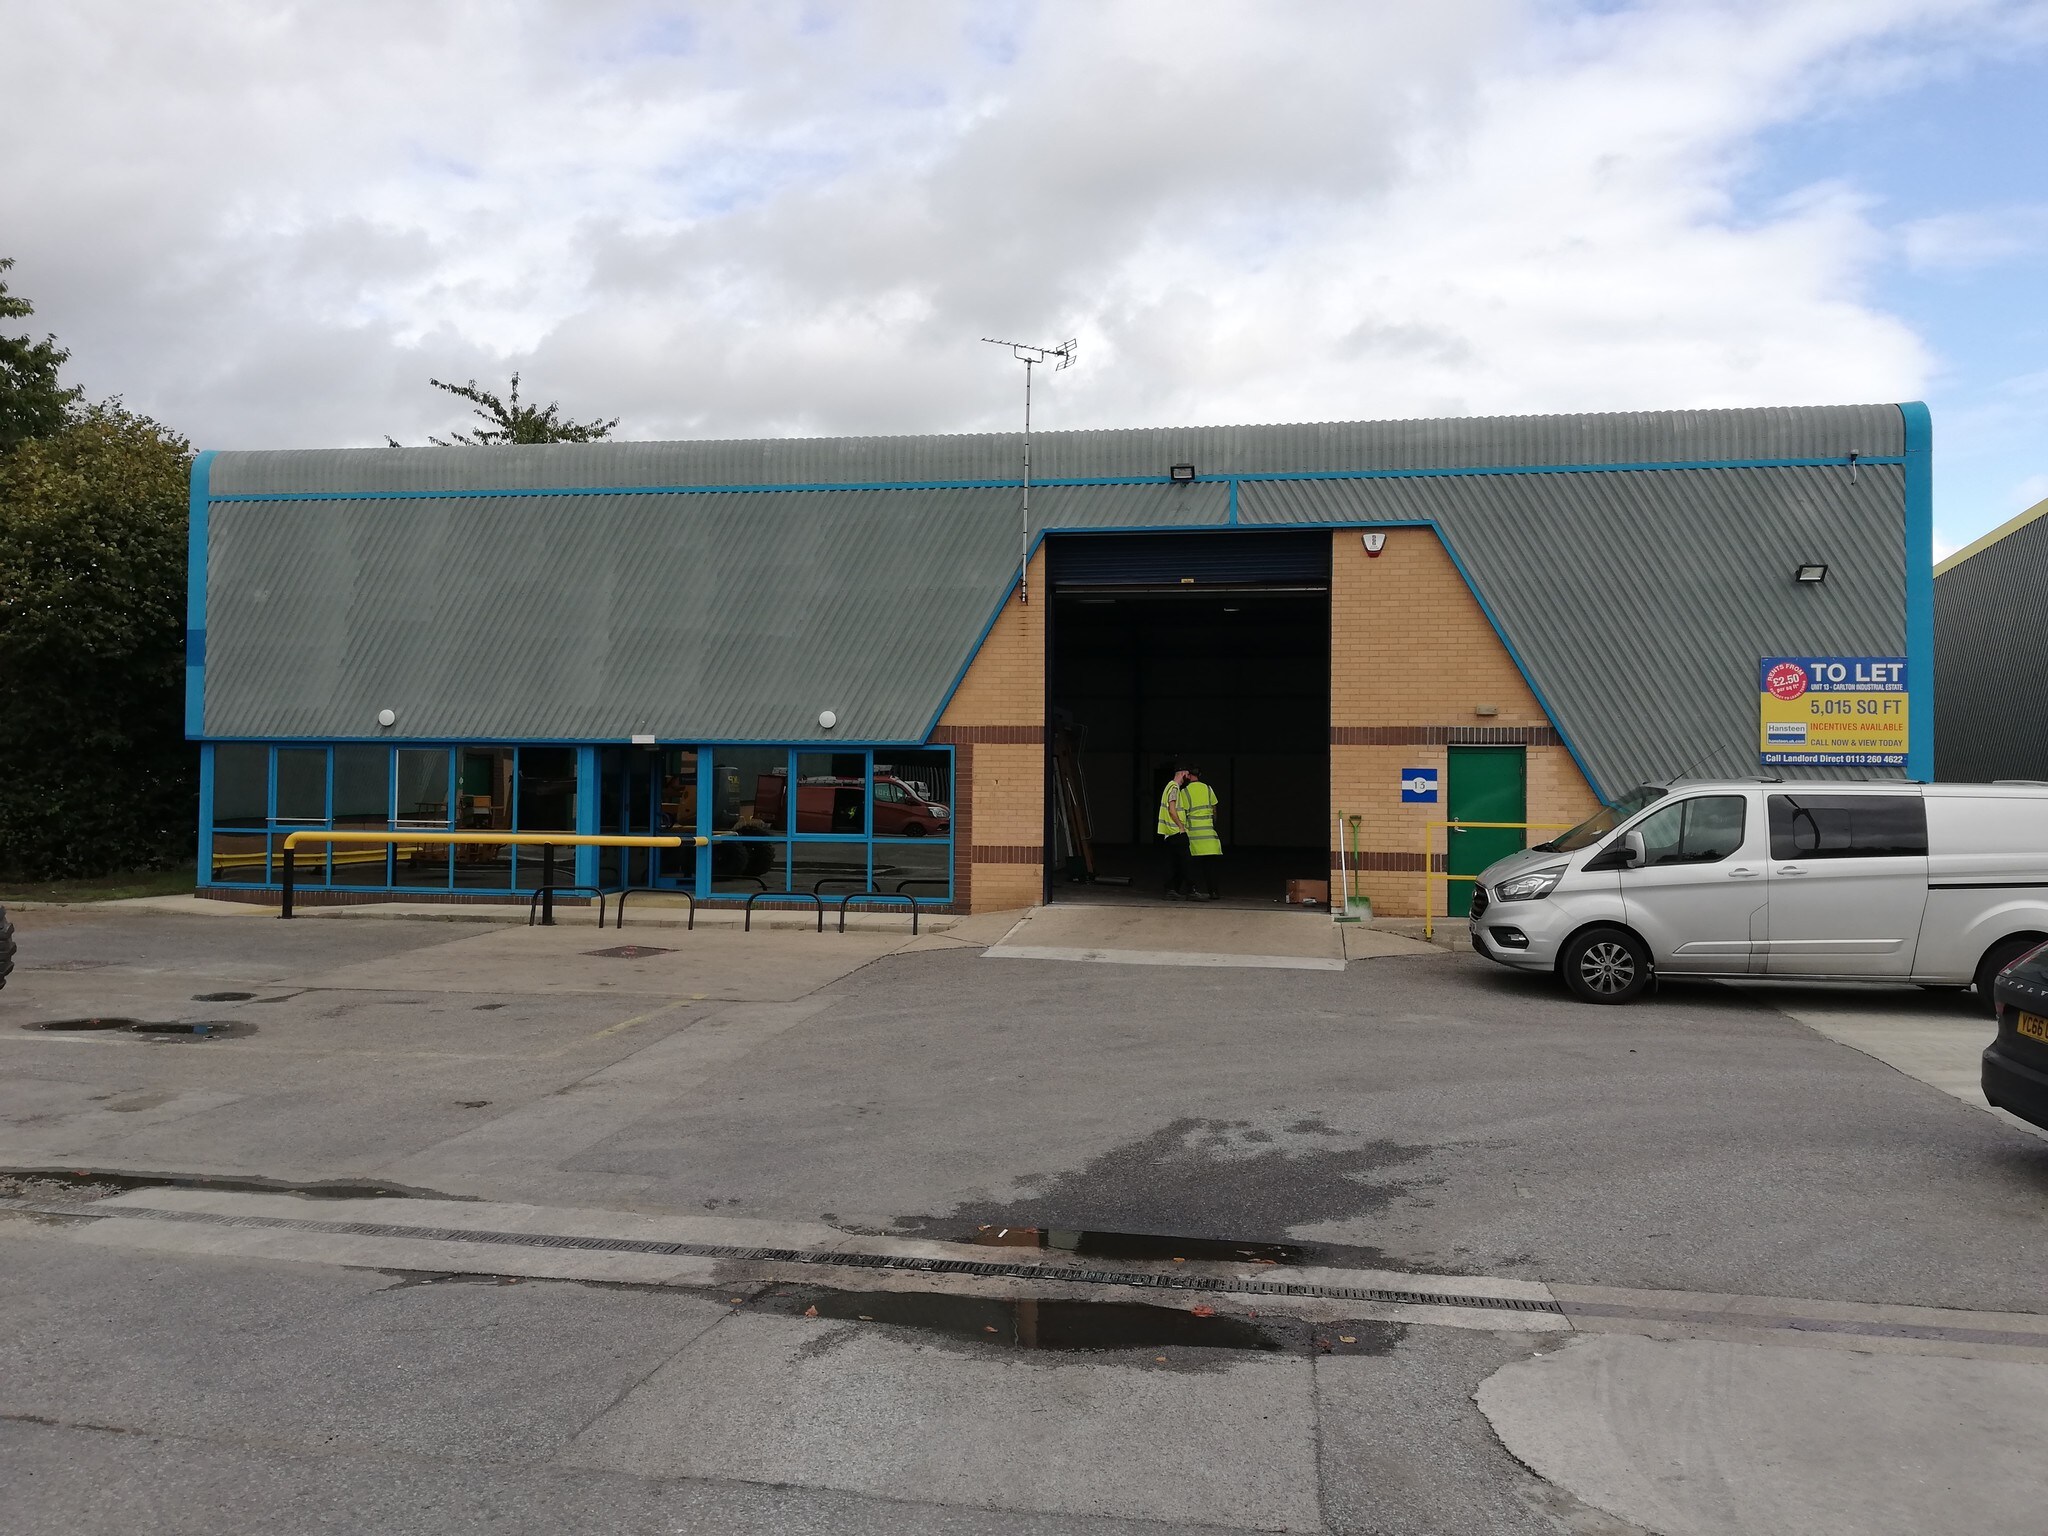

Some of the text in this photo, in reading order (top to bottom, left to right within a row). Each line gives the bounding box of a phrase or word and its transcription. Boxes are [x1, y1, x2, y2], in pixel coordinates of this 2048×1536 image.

[1768, 664, 1804, 681] RENTS FROM
[1773, 673, 1800, 687] £2.50
[1810, 663, 1903, 682] TO LET
[1810, 700, 1902, 716] 5,015 SQ FT
[1414, 781, 1426, 790] 13
[2022, 1016, 2044, 1036] YC66
